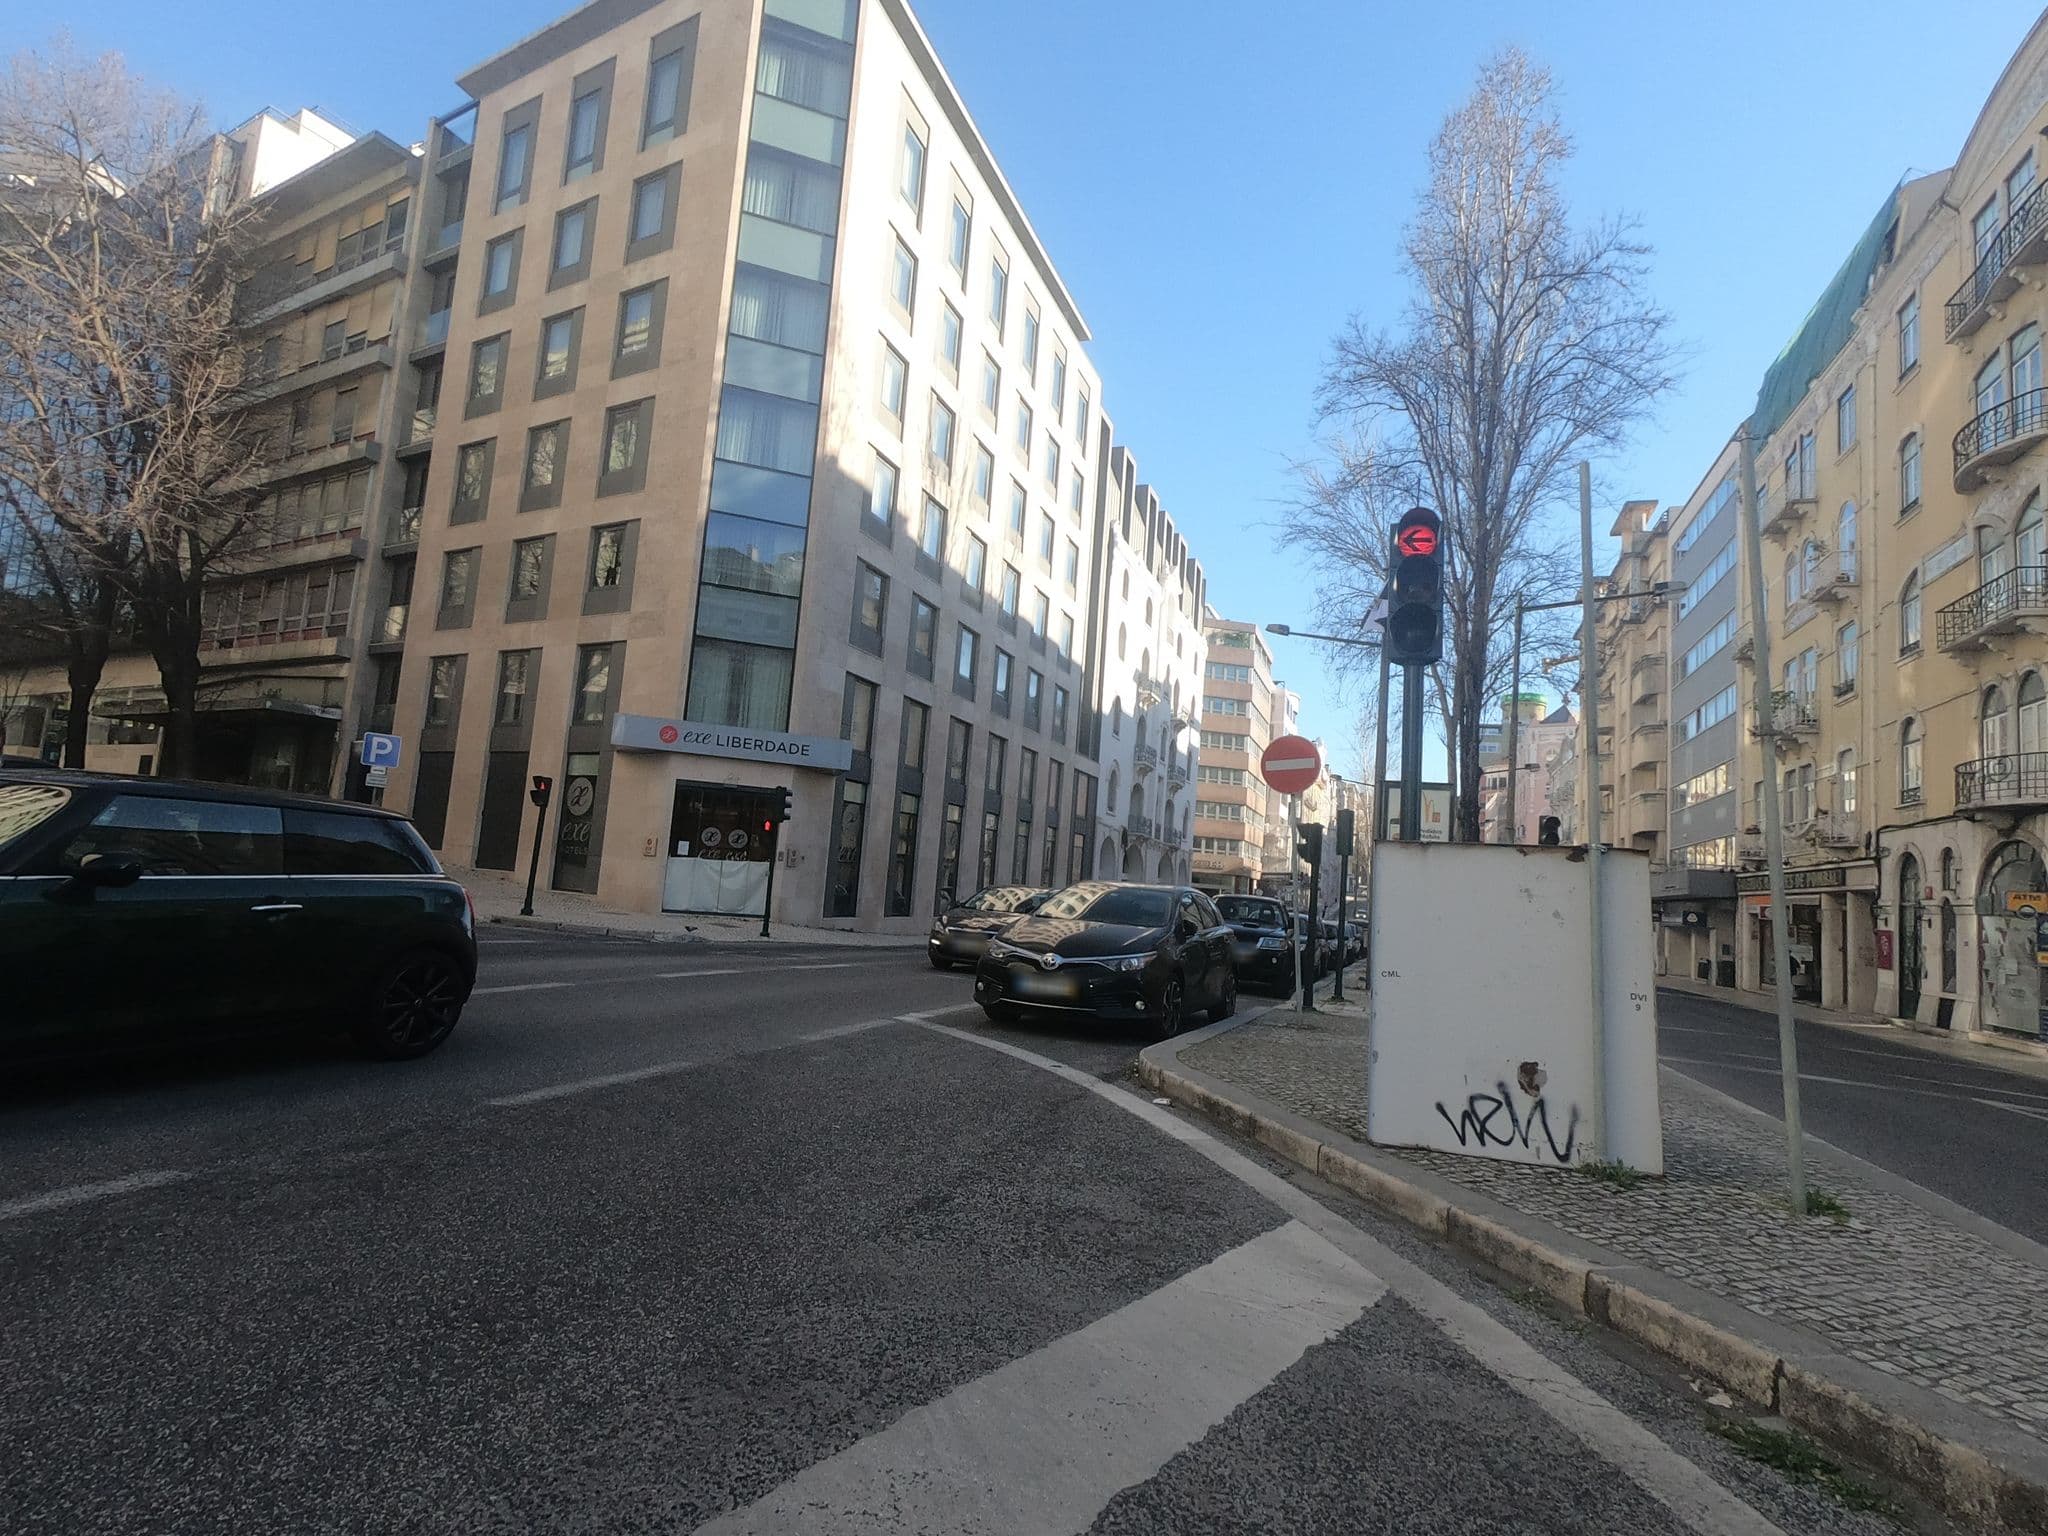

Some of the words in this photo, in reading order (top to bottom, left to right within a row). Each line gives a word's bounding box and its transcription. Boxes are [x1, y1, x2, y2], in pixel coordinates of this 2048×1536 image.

[369, 736, 393, 763] P
[683, 731, 712, 745] exe
[716, 734, 810, 757] LIBERDADE
[1381, 970, 1401, 978] CML
[1635, 1003, 1641, 1012] 9
